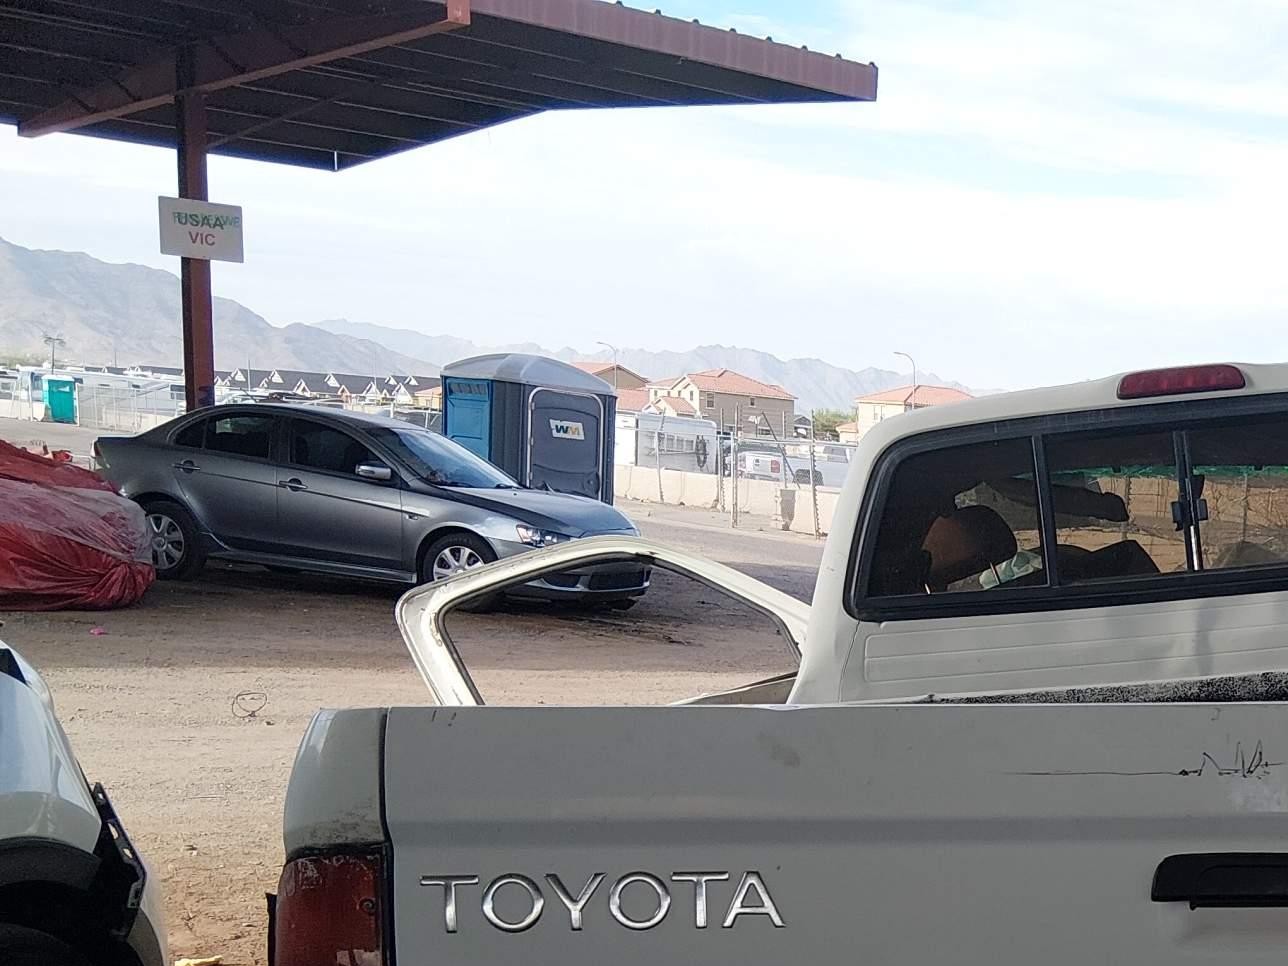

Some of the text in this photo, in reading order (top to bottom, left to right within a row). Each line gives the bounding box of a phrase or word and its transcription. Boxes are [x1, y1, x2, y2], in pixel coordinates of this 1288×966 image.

[177, 212, 224, 231] USAA
[188, 231, 216, 246] VIC
[555, 424, 580, 436] WM
[419, 871, 787, 933] TOYOTA
